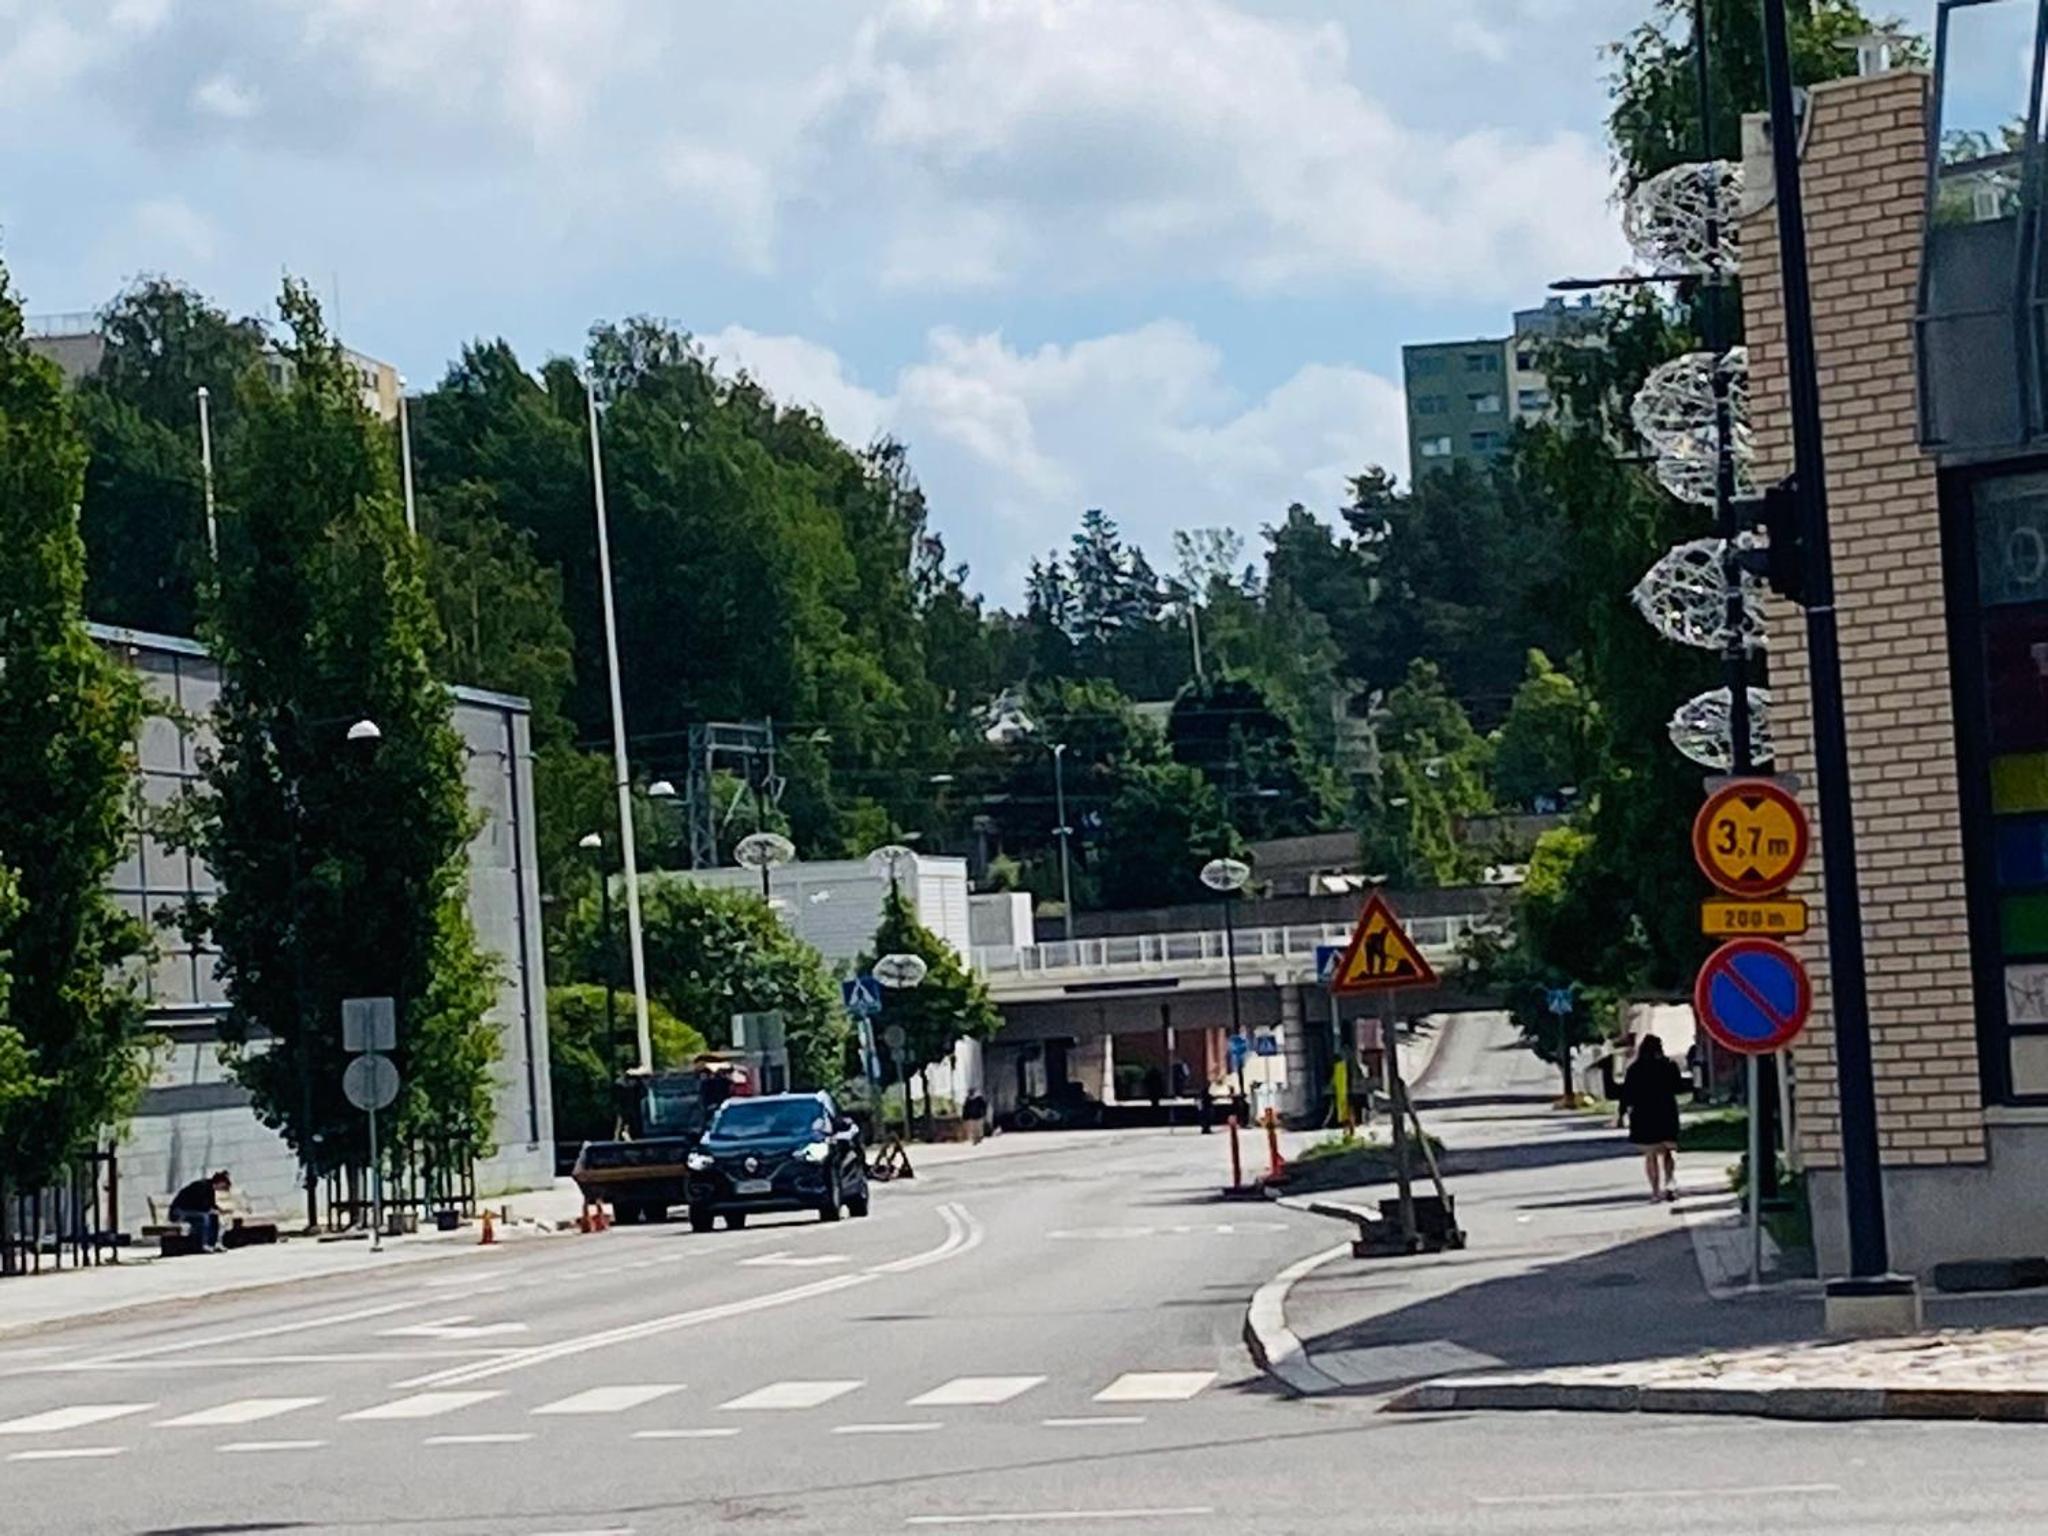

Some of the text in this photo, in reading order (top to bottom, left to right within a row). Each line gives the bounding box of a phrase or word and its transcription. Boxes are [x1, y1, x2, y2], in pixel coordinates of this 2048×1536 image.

[1716, 817, 1789, 858] 3,7 m
[1725, 909, 1785, 929] 200 m
